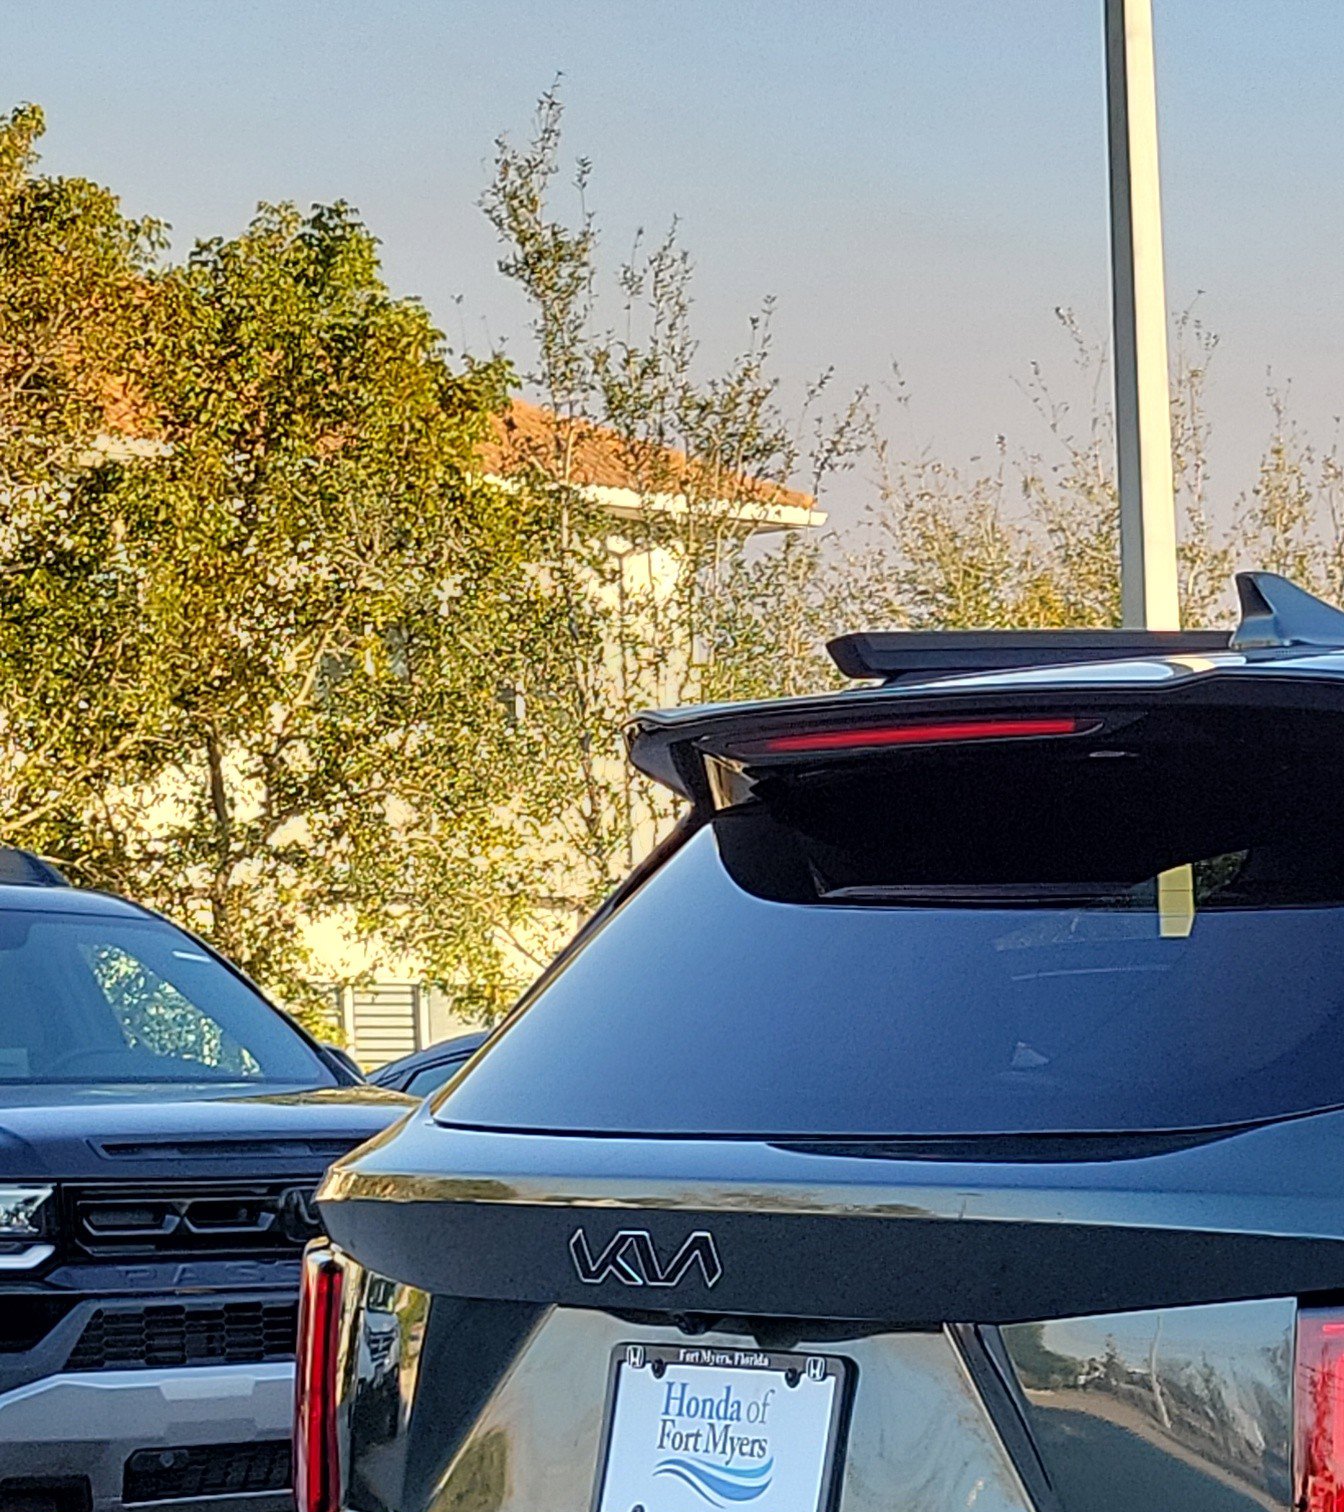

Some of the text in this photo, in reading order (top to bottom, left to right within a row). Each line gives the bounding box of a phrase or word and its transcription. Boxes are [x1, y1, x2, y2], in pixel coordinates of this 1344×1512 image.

[661, 1381, 776, 1424] Honda of
[657, 1418, 768, 1466] Fort Myers
